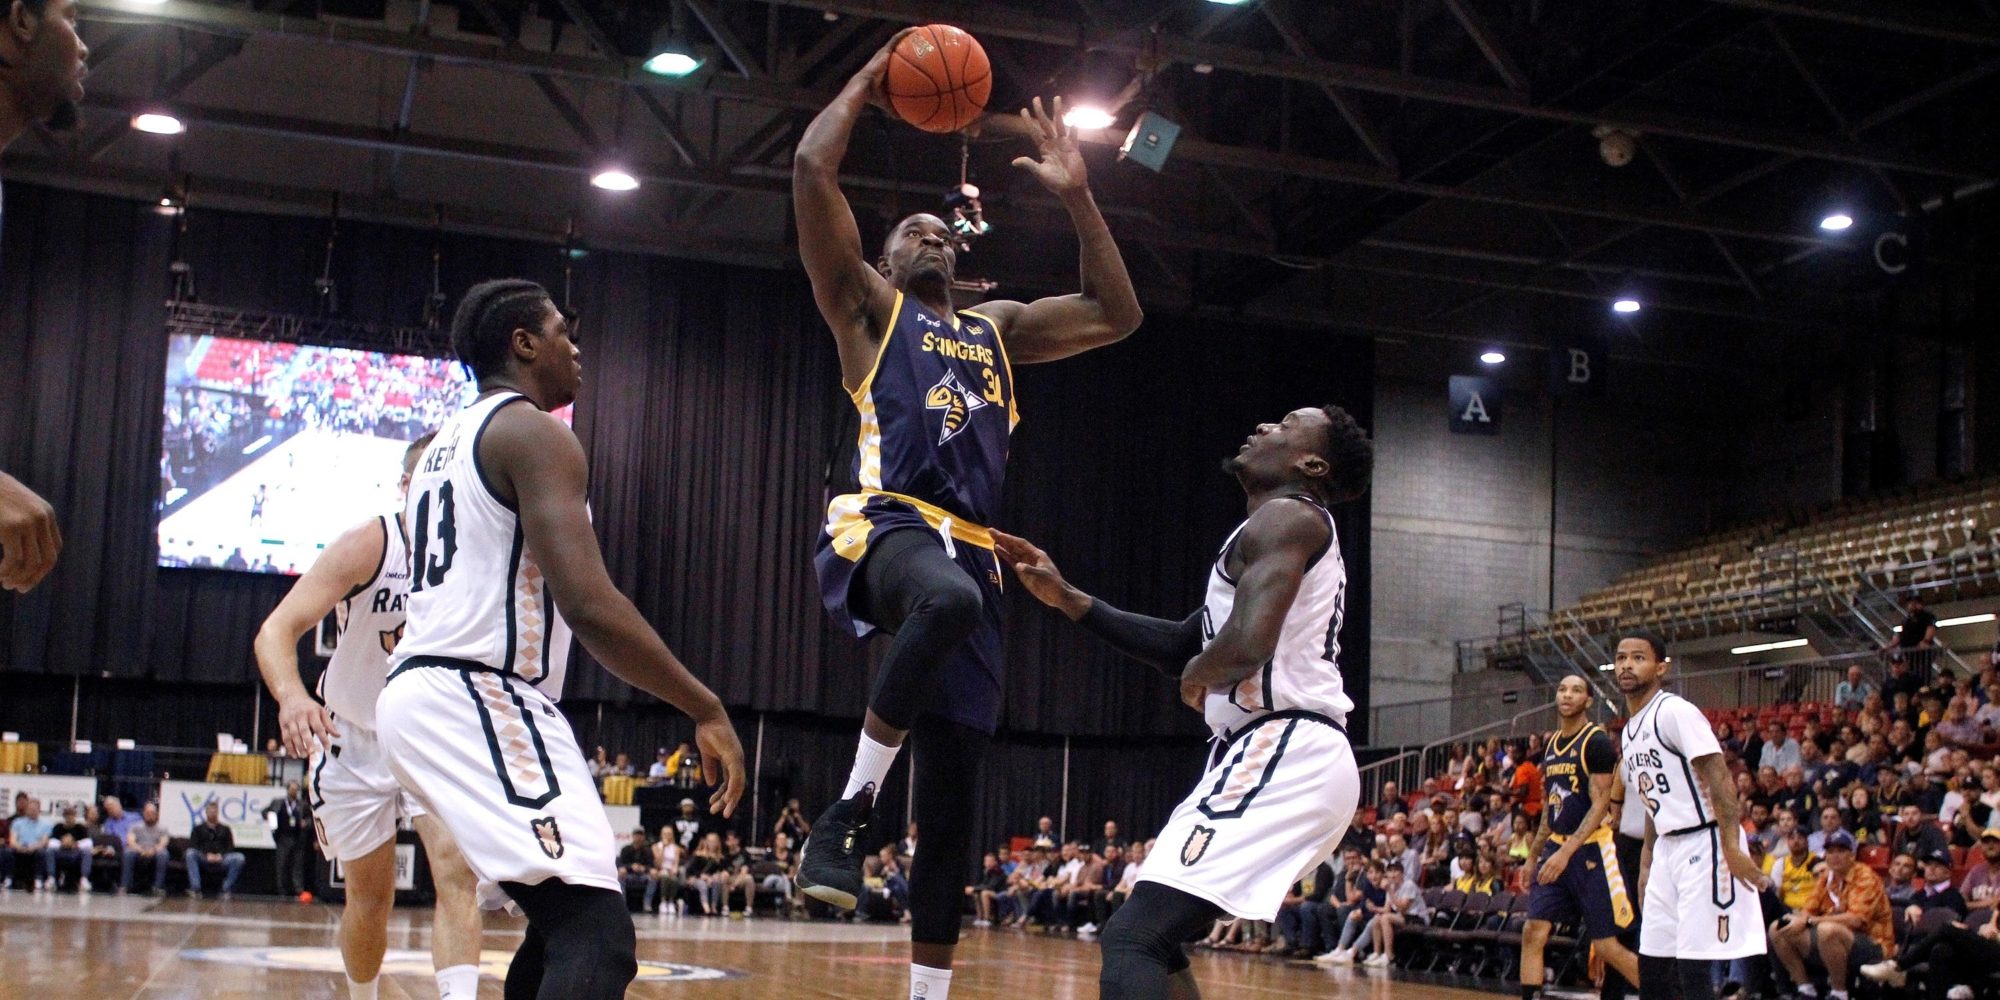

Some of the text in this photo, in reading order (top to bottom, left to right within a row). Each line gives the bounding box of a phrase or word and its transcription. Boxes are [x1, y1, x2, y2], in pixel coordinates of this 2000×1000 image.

[1874, 232, 1907, 274] C
[1567, 349, 1591, 383] B
[982, 367, 1004, 407] 31
[1461, 391, 1491, 422] A
[411, 478, 458, 592] 13
[1624, 748, 1663, 773] ATLERS
[1568, 775, 1580, 794] 2
[1655, 773, 1671, 794] 9
